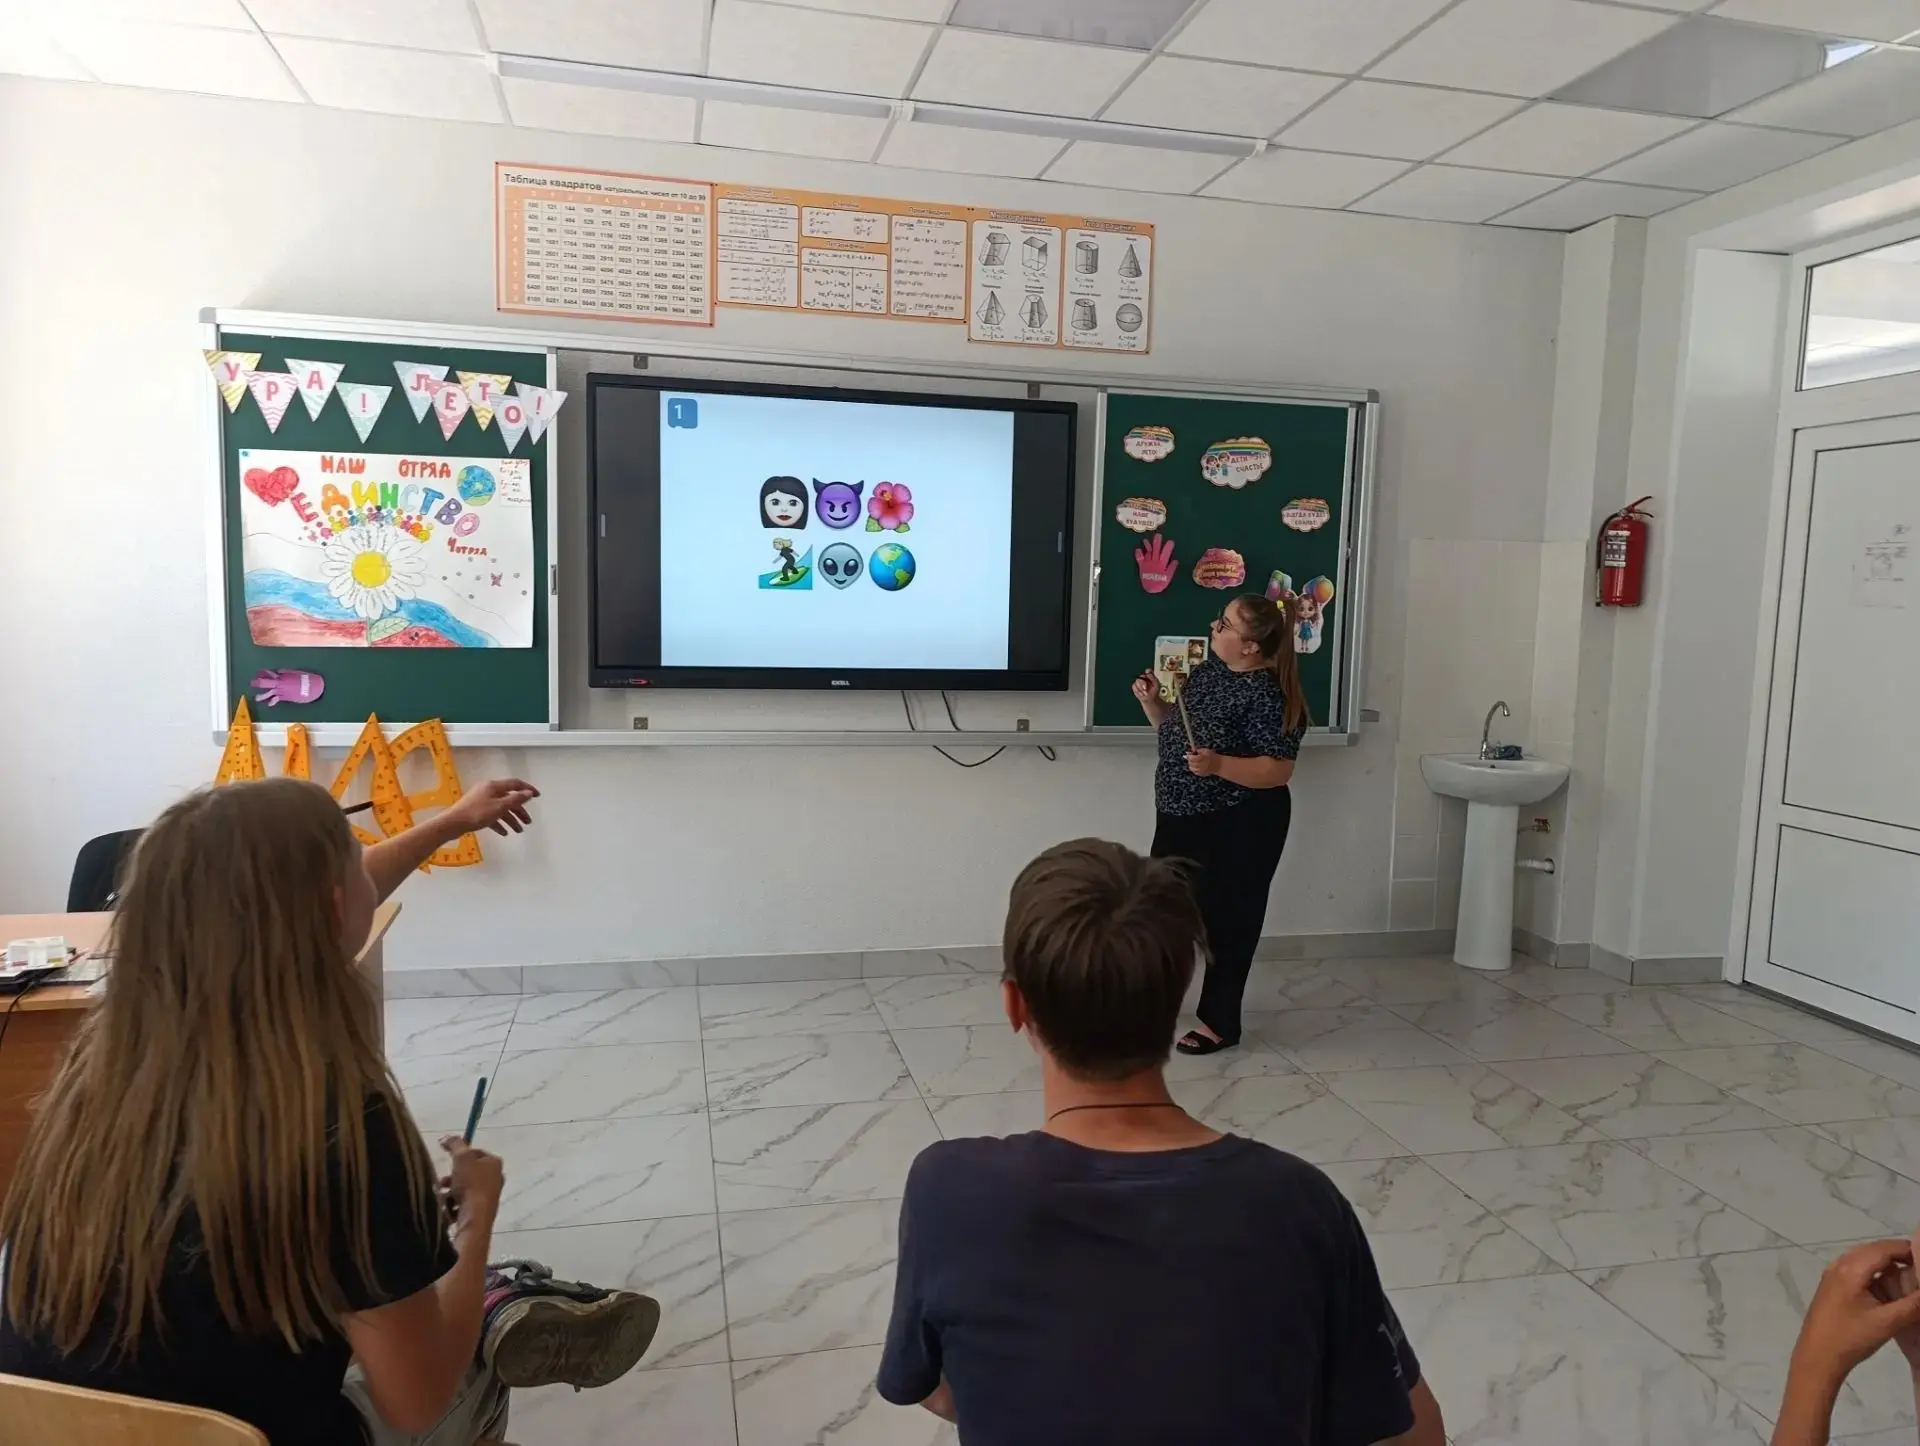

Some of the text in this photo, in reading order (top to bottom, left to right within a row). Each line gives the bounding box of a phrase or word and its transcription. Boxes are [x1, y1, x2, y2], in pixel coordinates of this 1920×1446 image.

[504, 174, 547, 186] Таблица
[550, 178, 602, 190] квадратов
[224, 362, 543, 424] УРА! ЛЕТО!
[674, 404, 682, 420] 1
[320, 455, 452, 478] НАШ ОТРЯД
[1236, 463, 1264, 472] СЧАСТЬЕ
[290, 480, 480, 537] ЕДИНСТВО
